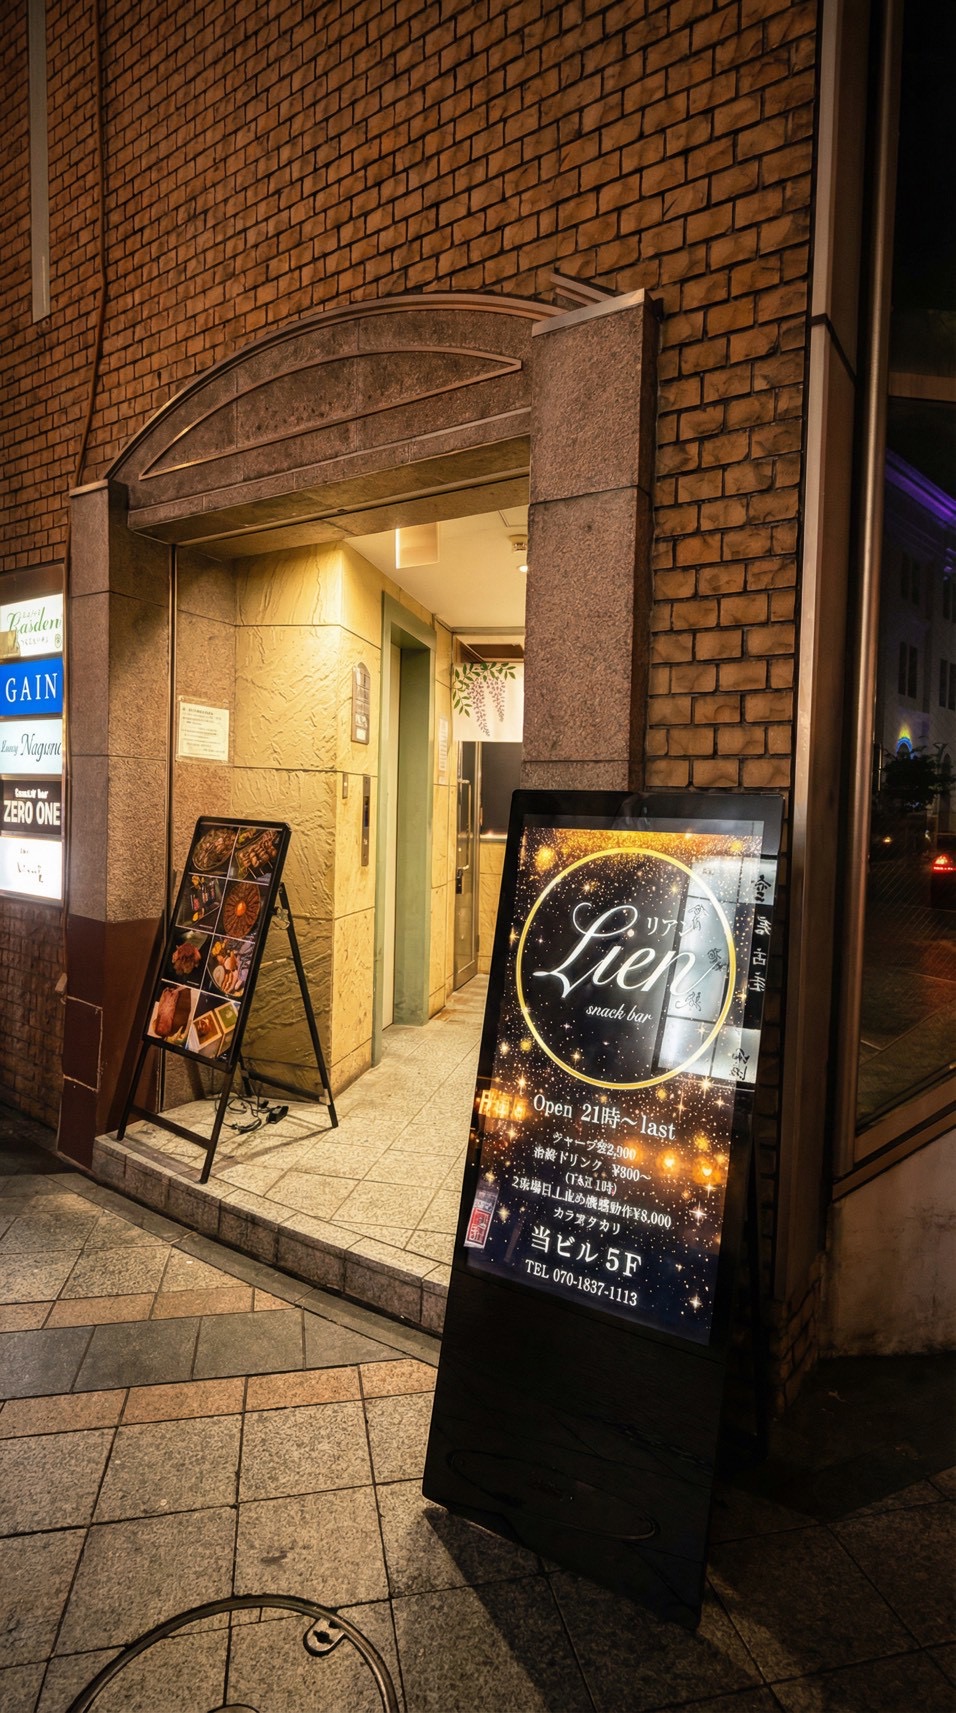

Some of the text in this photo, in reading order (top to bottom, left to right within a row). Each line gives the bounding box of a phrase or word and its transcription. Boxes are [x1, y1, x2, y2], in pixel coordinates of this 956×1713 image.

[5, 673, 57, 703] GAIN
[3, 799, 61, 826] ZERO ONE
[646, 916, 696, 937] リアン
[533, 902, 724, 999] Lien
[585, 1003, 653, 1024] snack bar
[533, 1094, 573, 1118] Open
[531, 1225, 642, 1277] 当ビル 5F
[525, 1259, 638, 1307] TEL 070-1837-1113
